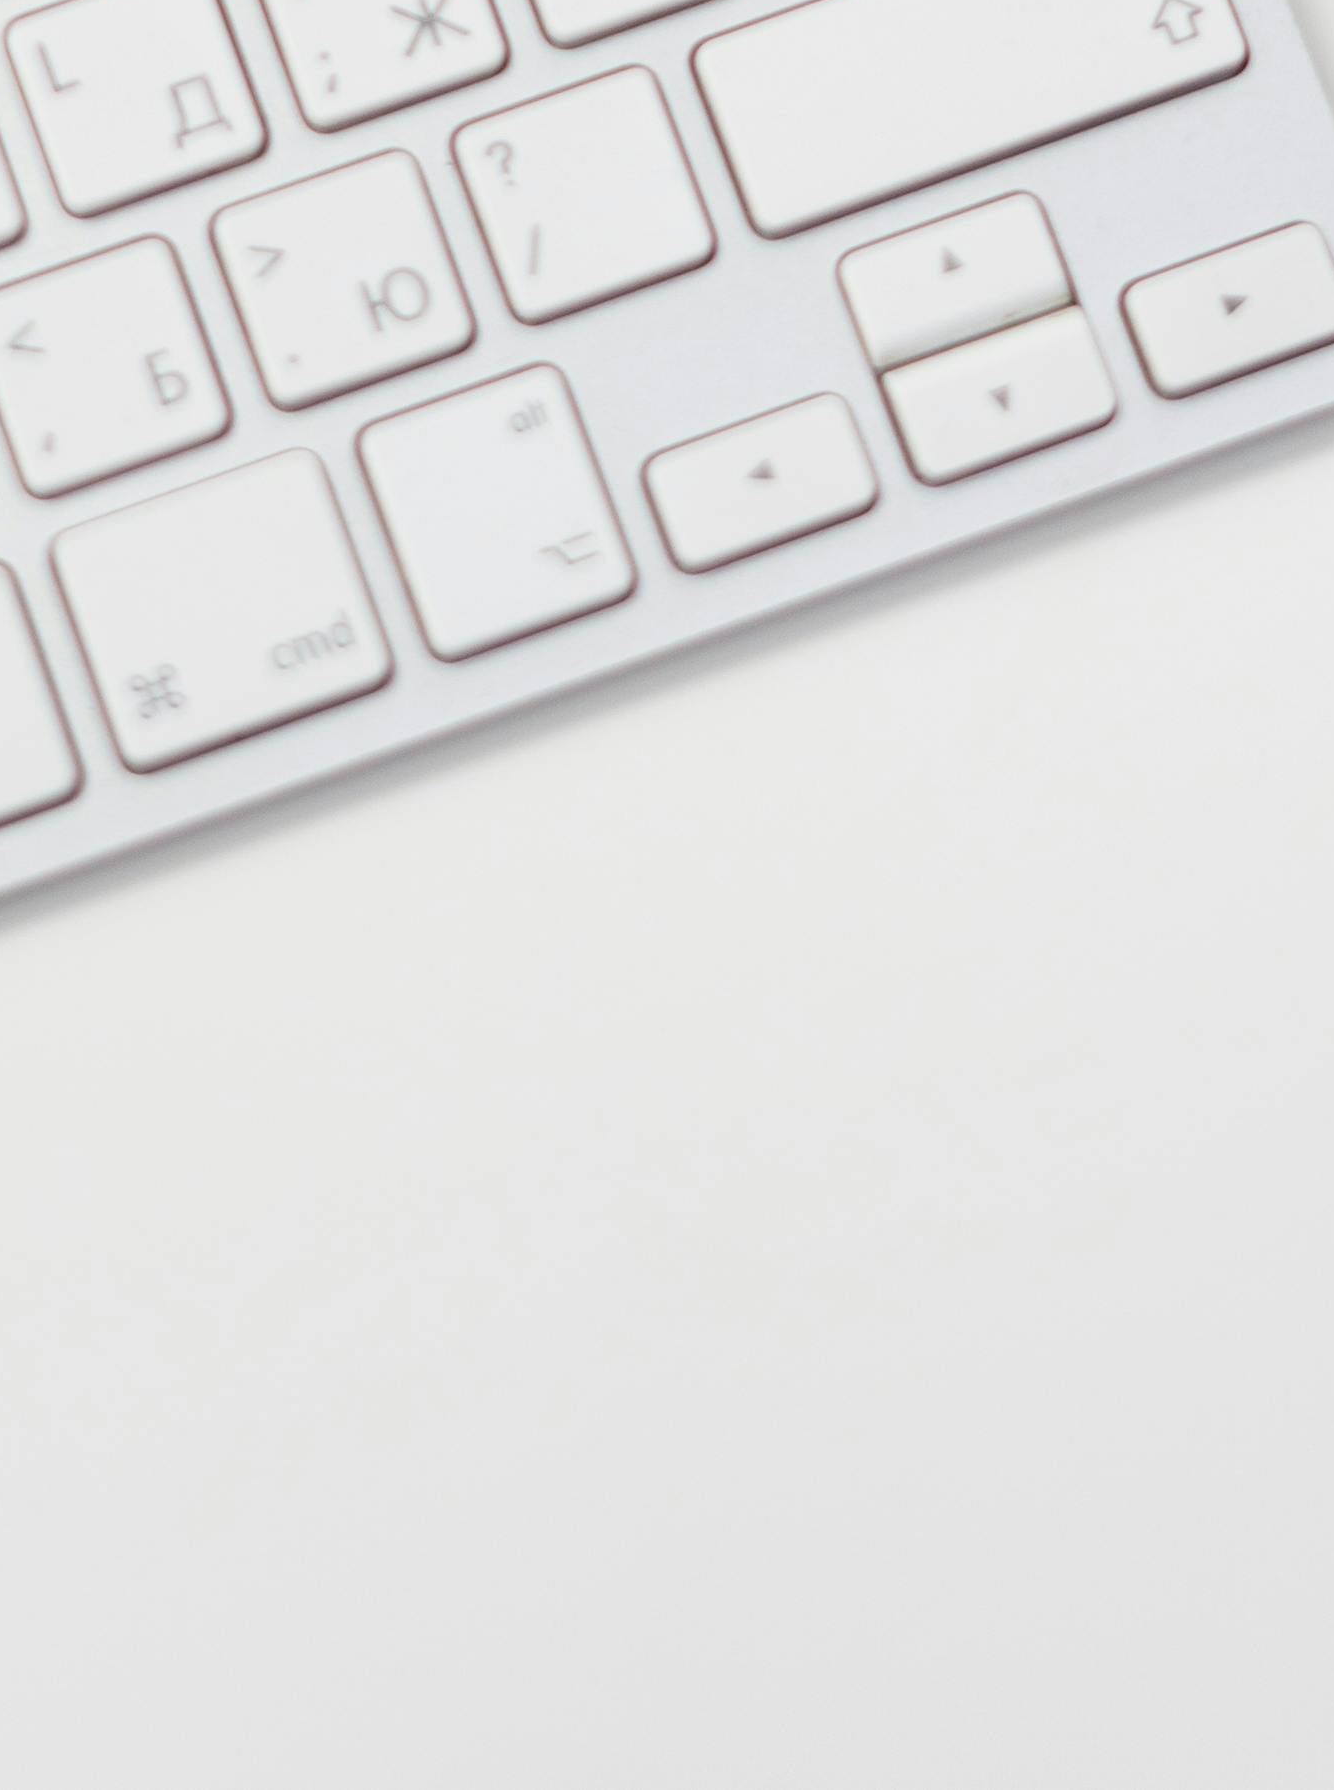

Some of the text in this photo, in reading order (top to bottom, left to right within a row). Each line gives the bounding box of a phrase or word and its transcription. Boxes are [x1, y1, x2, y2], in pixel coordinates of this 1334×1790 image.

[35, 42, 80, 96] L
[168, 75, 231, 148] Д
[360, 267, 432, 333] Ю
[144, 350, 190, 408] Б
[508, 400, 549, 435] alt
[269, 614, 357, 673] cmd
